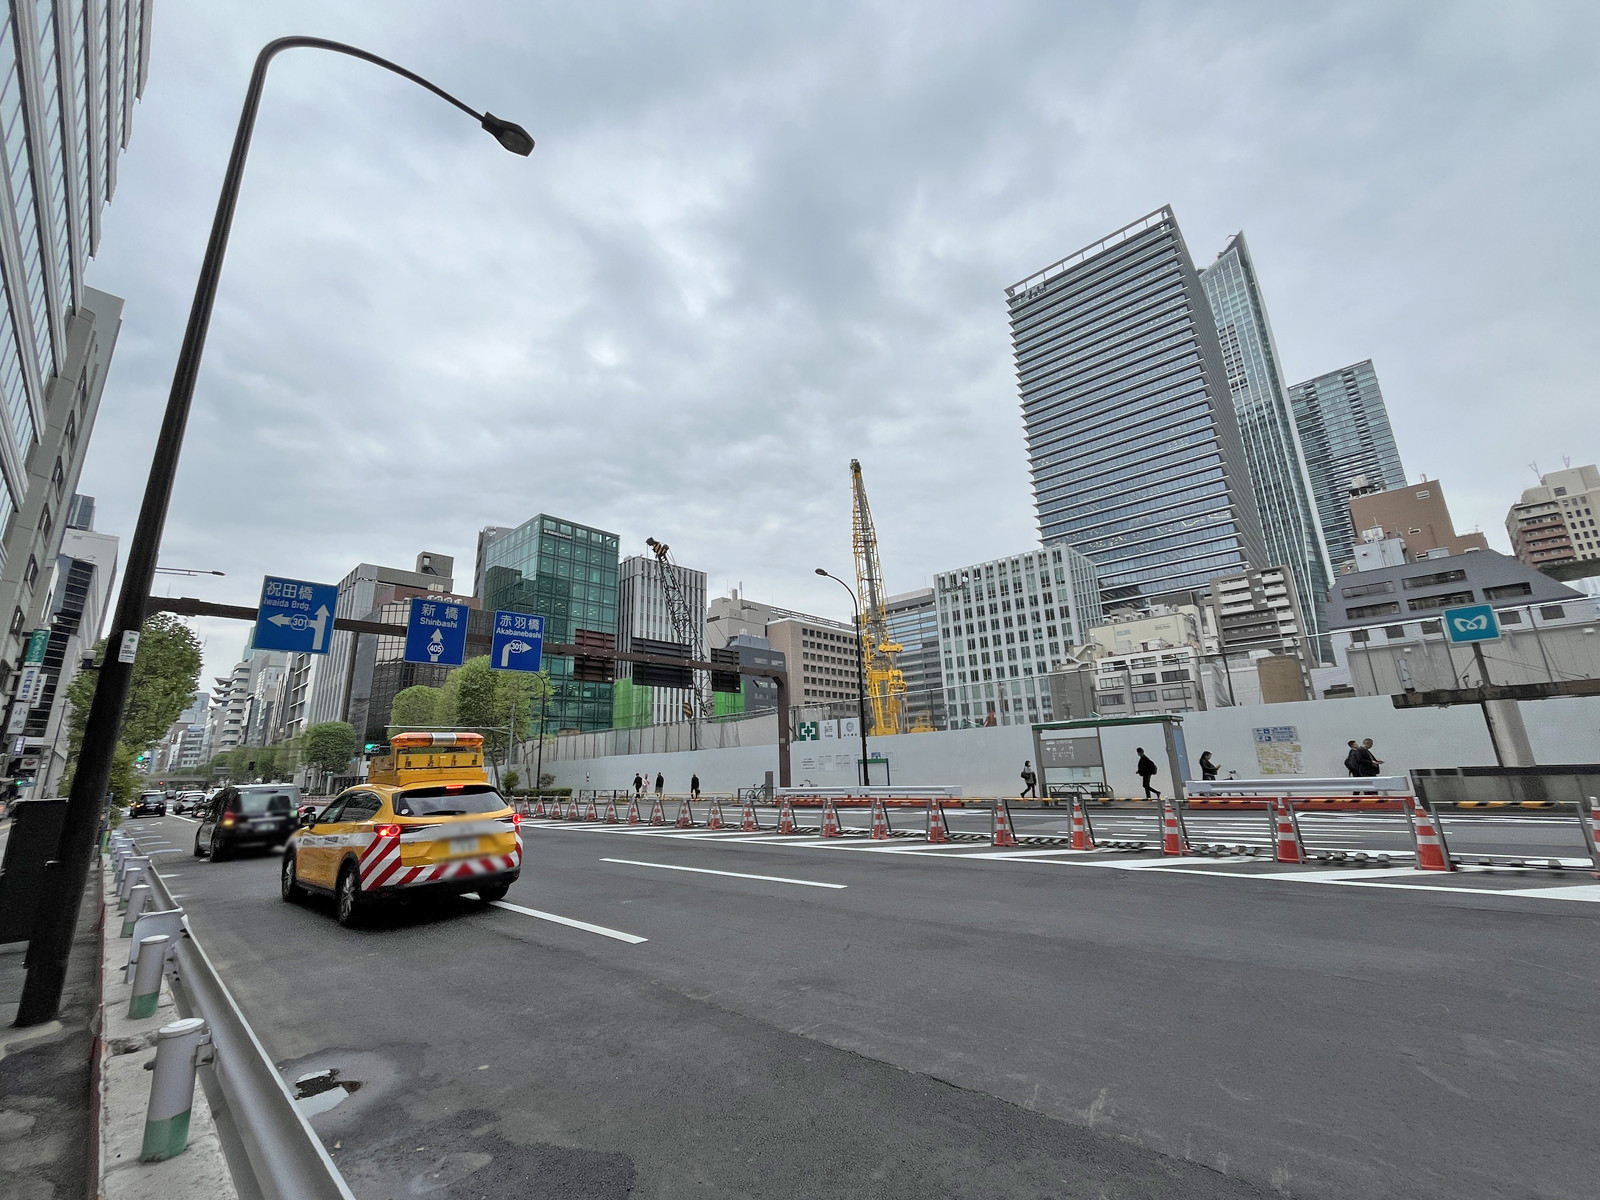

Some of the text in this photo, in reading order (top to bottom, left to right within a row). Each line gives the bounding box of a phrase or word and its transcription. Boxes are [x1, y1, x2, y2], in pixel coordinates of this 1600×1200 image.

[266, 581, 314, 601] 祝田橋
[263, 597, 311, 612] Iwaida Brdg.
[421, 603, 459, 620] 新橋
[292, 617, 308, 627] 301
[420, 617, 458, 628] Shinbashi
[500, 614, 540, 631] 赤羽橋
[496, 627, 542, 639] Akabanebashi
[429, 644, 442, 653] 405
[511, 642, 522, 651] 301
